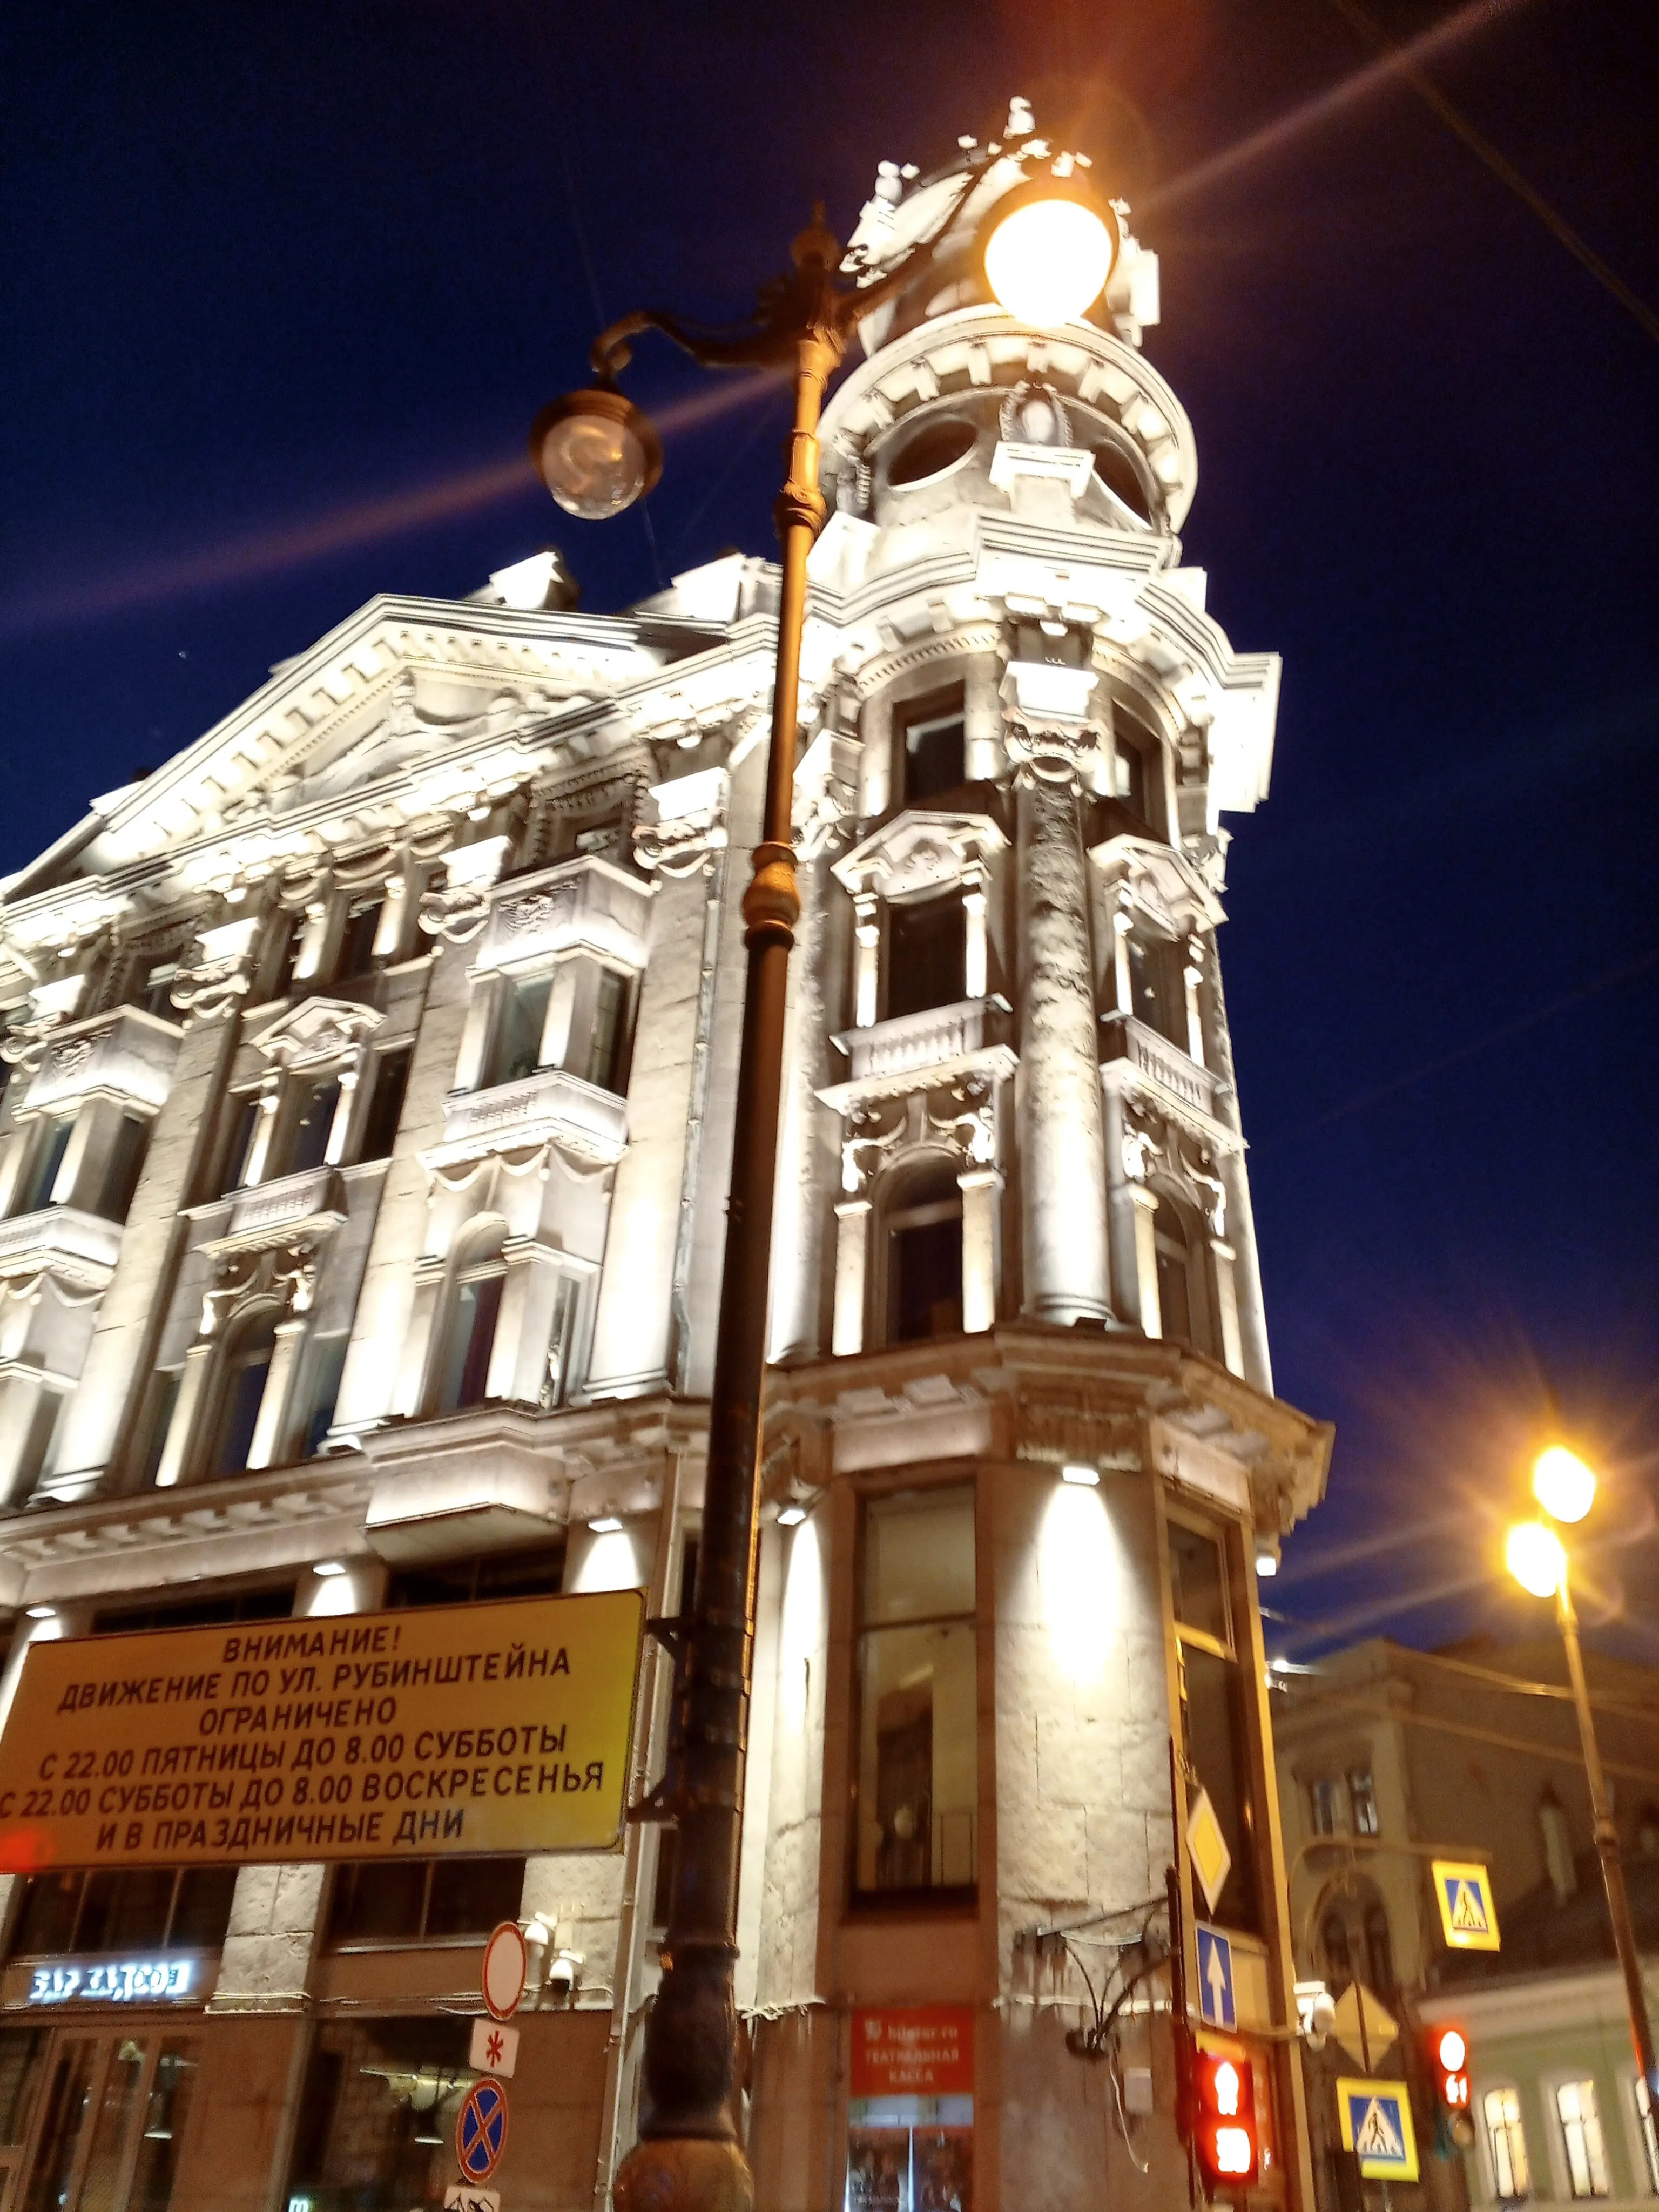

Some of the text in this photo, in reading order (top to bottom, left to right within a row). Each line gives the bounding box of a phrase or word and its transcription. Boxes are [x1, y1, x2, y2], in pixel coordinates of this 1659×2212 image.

[222, 1626, 401, 1663] ВНИМАНИЕ!
[57, 1642, 570, 1714] ДВИЖЕНИЕ ПО УЛ. РУБИНШТЕЙНА
[199, 1696, 396, 1736] ОГРАНИЧЕНО
[39, 1724, 567, 1781] С 22.00 ПЯТНИЦЫ ДО 8.00 СУББОТЫ
[0, 1761, 604, 1818] С 22.00 СУББОТЫ ДО 8.00 ВОСКРЕСЕНЬЯ
[96, 1808, 464, 1852] И В ПРАЗДНИЧНЫЕ ДНИ
